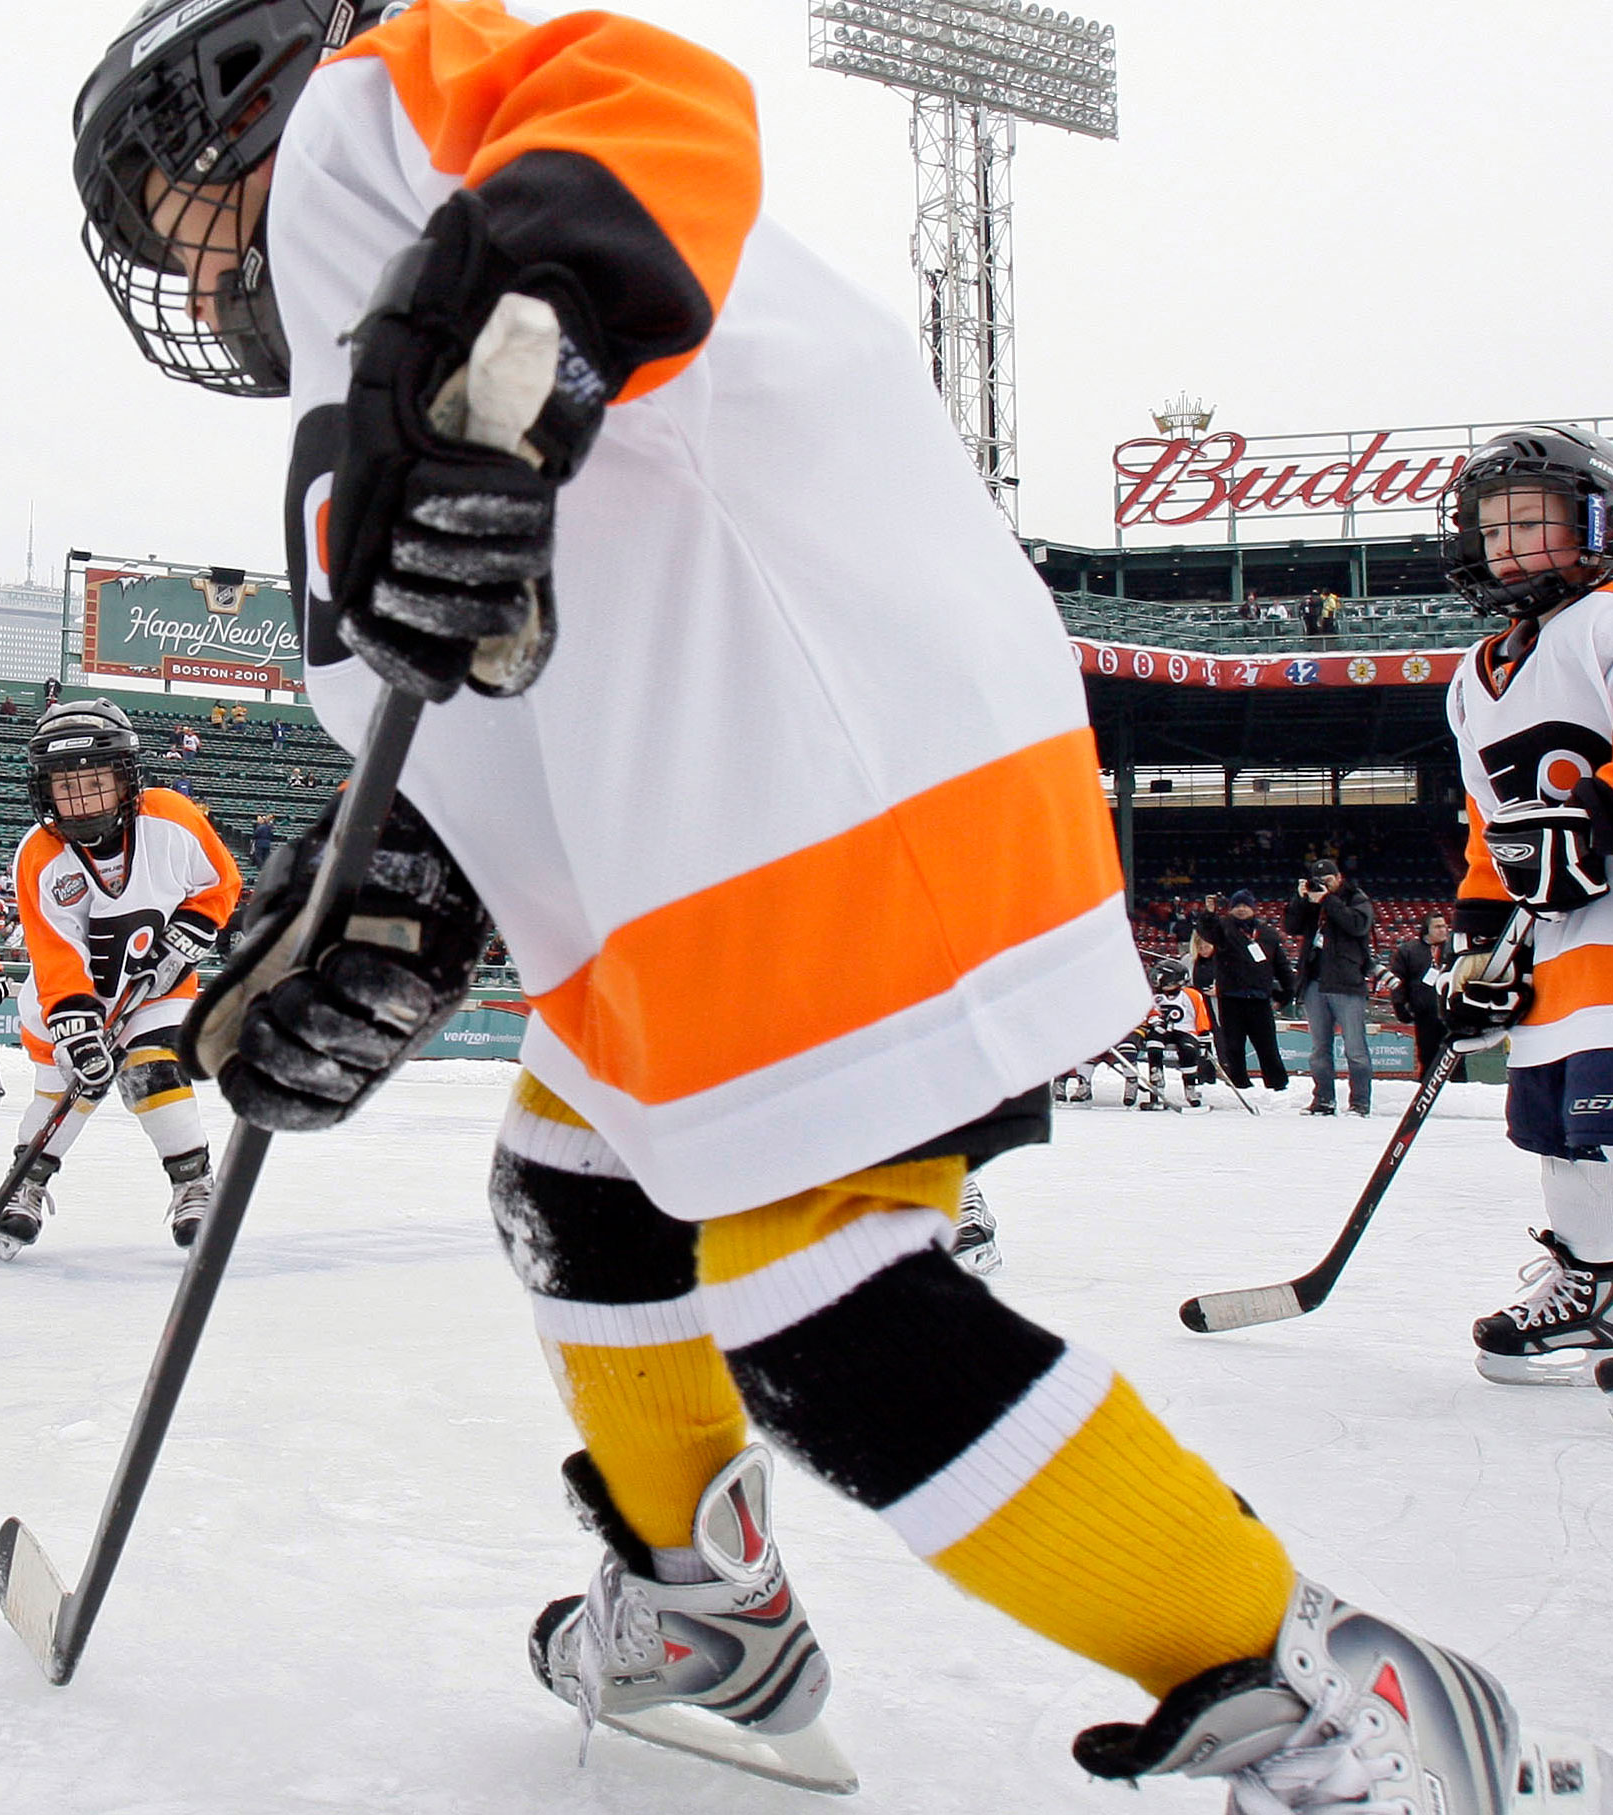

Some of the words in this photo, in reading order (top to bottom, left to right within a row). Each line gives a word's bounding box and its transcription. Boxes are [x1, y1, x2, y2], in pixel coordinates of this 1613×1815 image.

[124, 606, 209, 656] Happy
[207, 614, 263, 645] New
[255, 620, 301, 667] Yea
[1286, 661, 1321, 684] 42
[443, 1029, 490, 1045] verizon
[1573, 1098, 1613, 1110] CC
